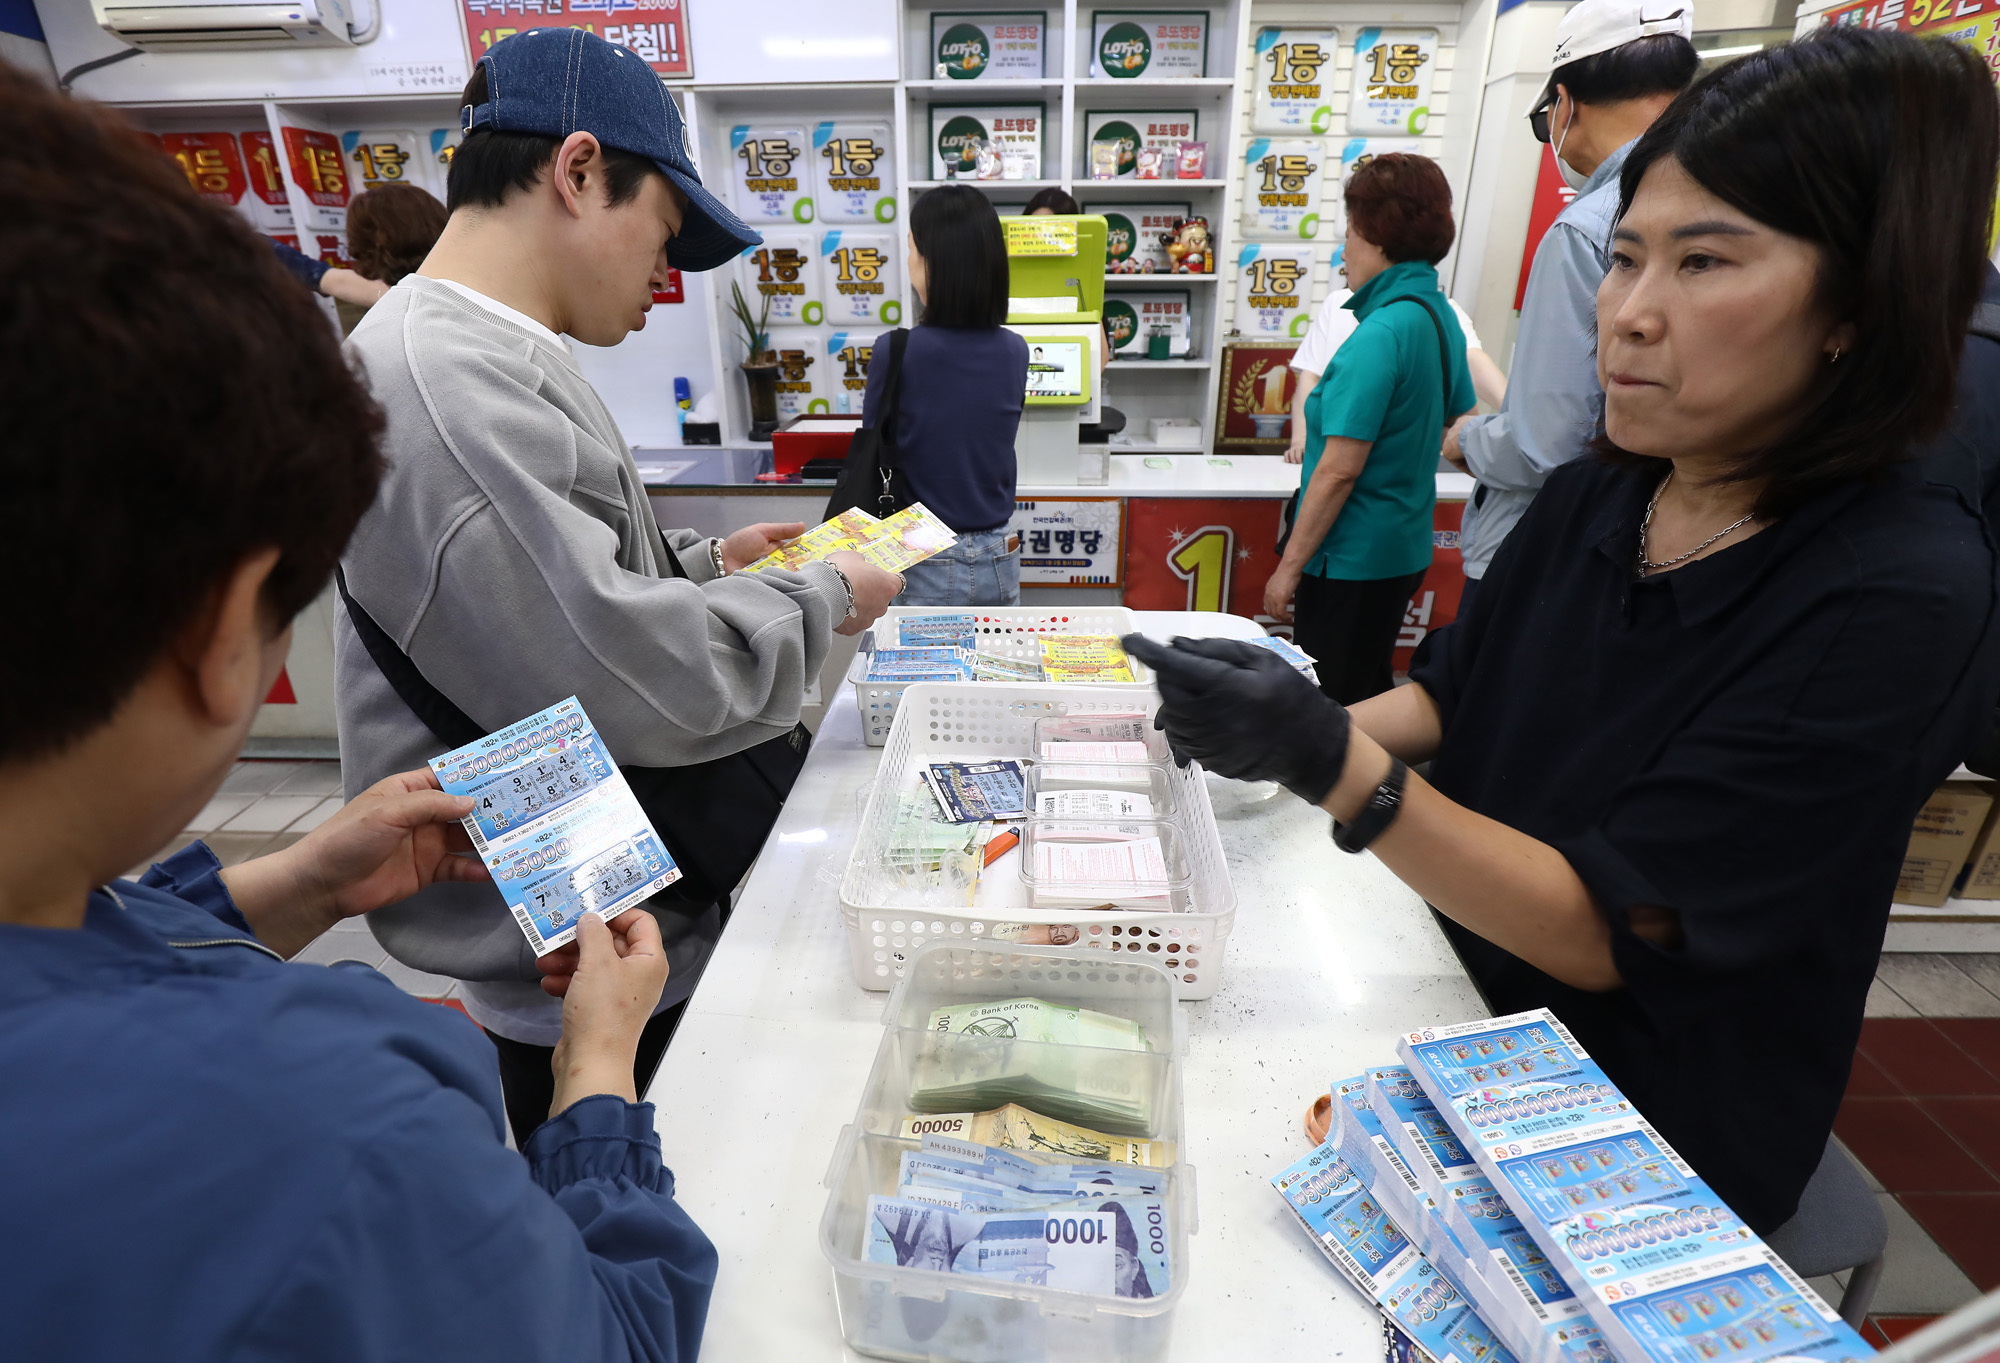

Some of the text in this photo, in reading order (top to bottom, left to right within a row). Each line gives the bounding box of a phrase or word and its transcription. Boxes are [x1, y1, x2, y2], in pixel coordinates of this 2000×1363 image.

[1103, 41, 1144, 57] LOTTO
[993, 118, 1036, 132] 로또명당
[1147, 123, 1190, 136] 로또명당
[559, 756, 567, 764] 4
[536, 766, 545, 775] 1
[513, 777, 522, 787] 9
[569, 774, 577, 783] 6
[547, 785, 556, 795] 8
[482, 797, 493, 810] 4
[523, 796, 532, 806] 7
[623, 868, 633, 878] 3
[602, 880, 611, 891] 2
[535, 894, 546, 908] 7
[981, 1002, 1039, 1016] Bank of Korea
[911, 1119, 964, 1135] 50000
[1046, 1218, 1108, 1245] 1000
[1146, 1204, 1165, 1255] 1000
